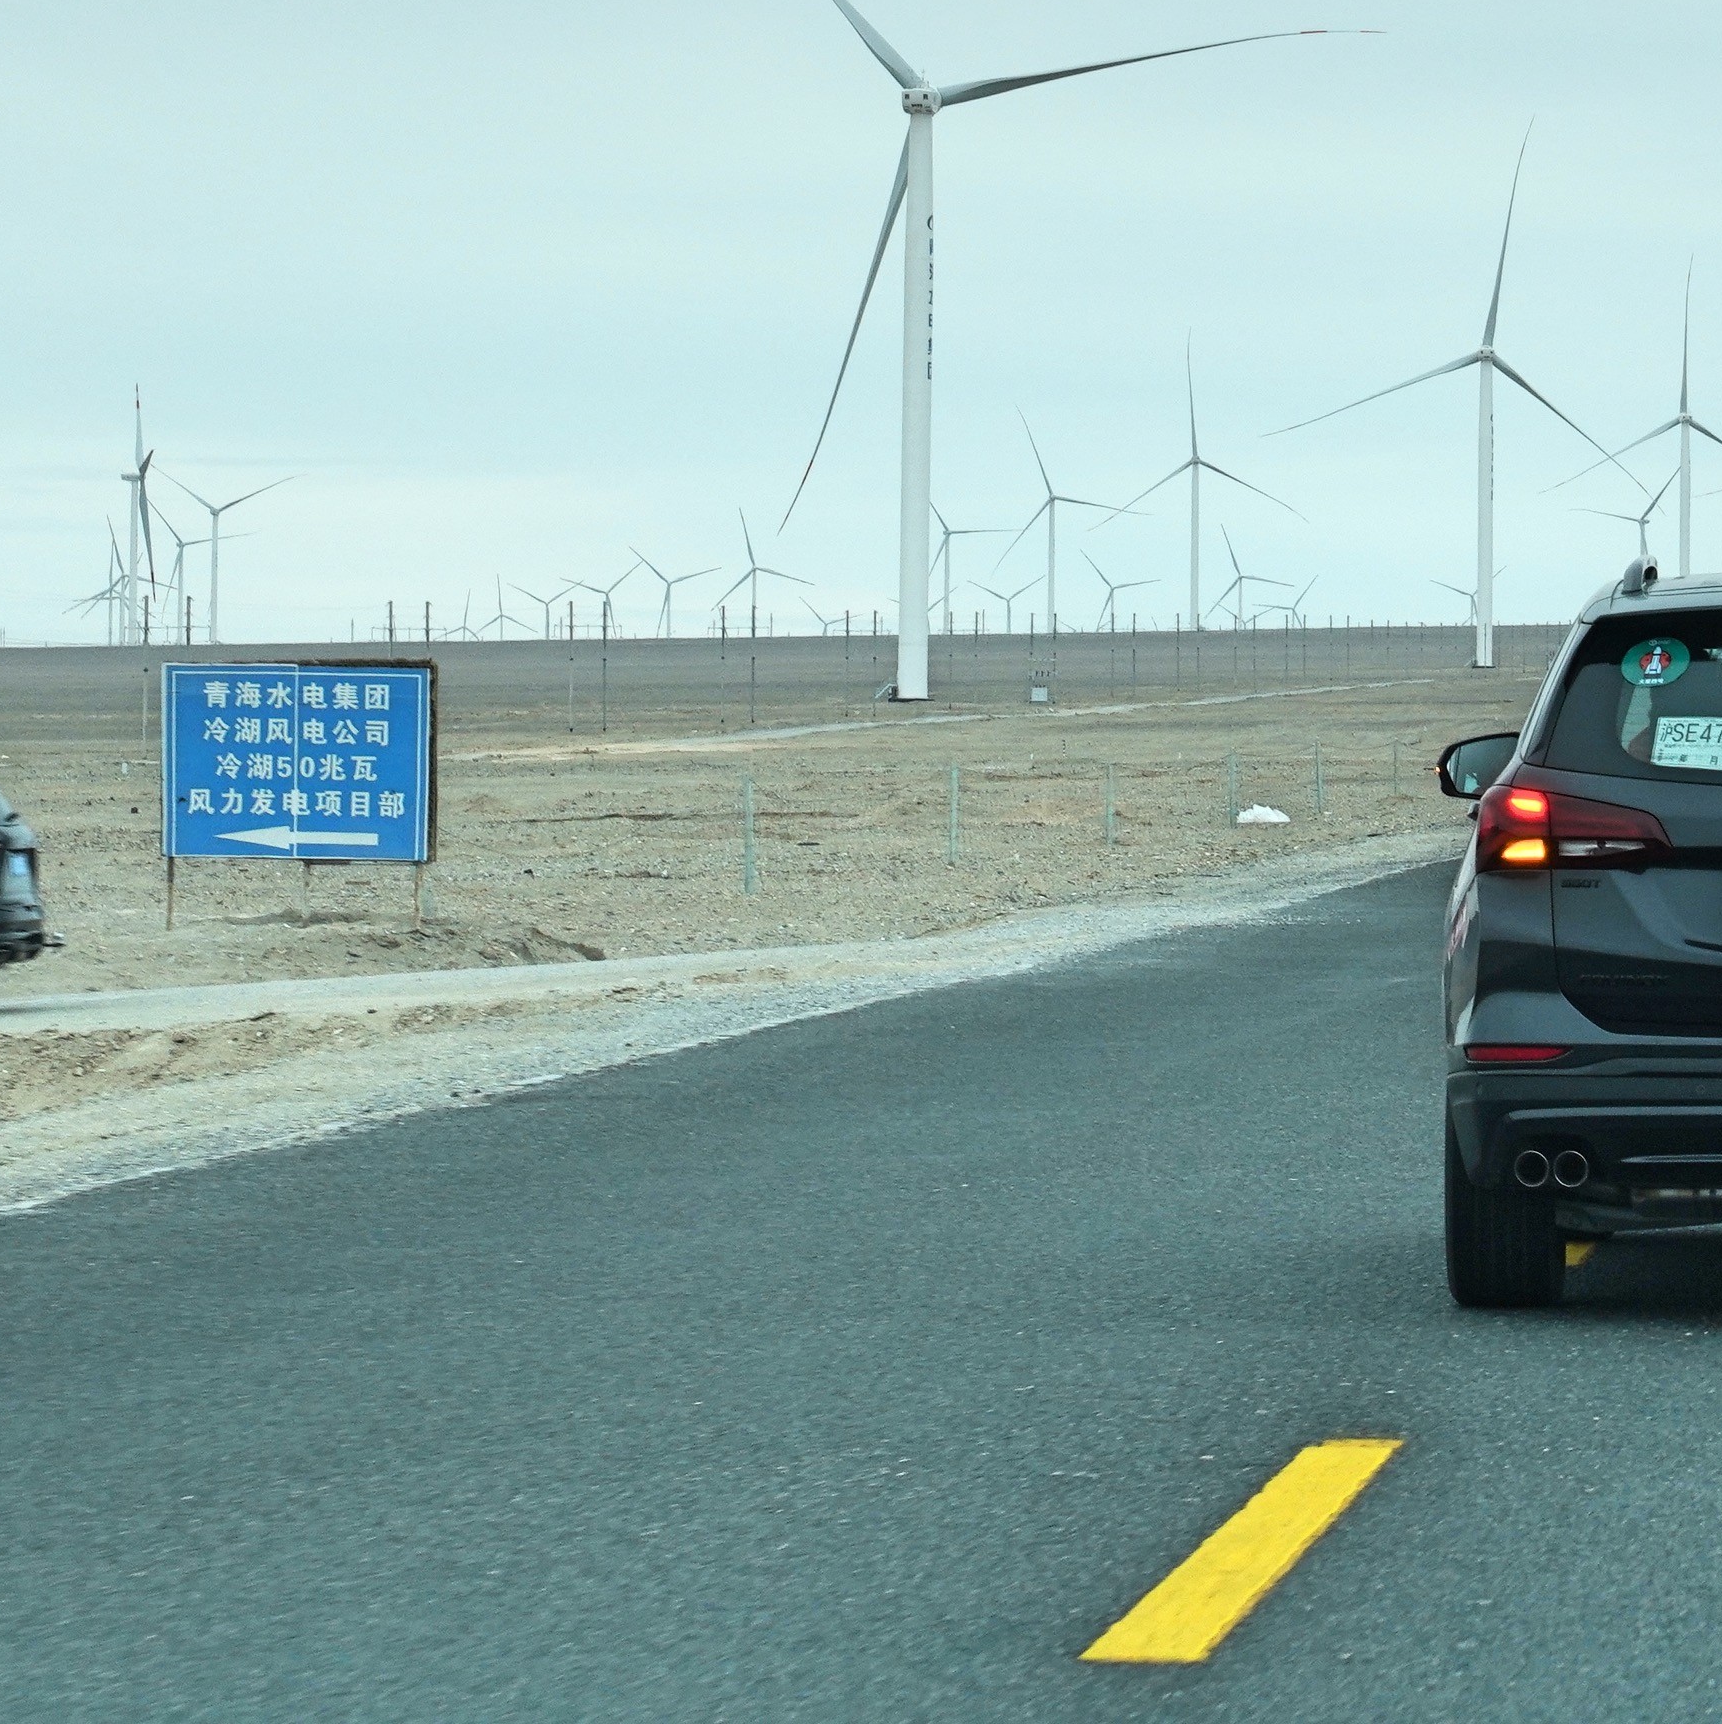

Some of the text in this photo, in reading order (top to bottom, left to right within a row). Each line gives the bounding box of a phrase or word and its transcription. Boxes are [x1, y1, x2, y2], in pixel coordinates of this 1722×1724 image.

[203, 681, 390, 711] 青海水电集团
[203, 717, 389, 746] 冷湖风电公司
[215, 753, 378, 782] 冷湖50兆瓦
[187, 788, 406, 819] 风力发电项目部
